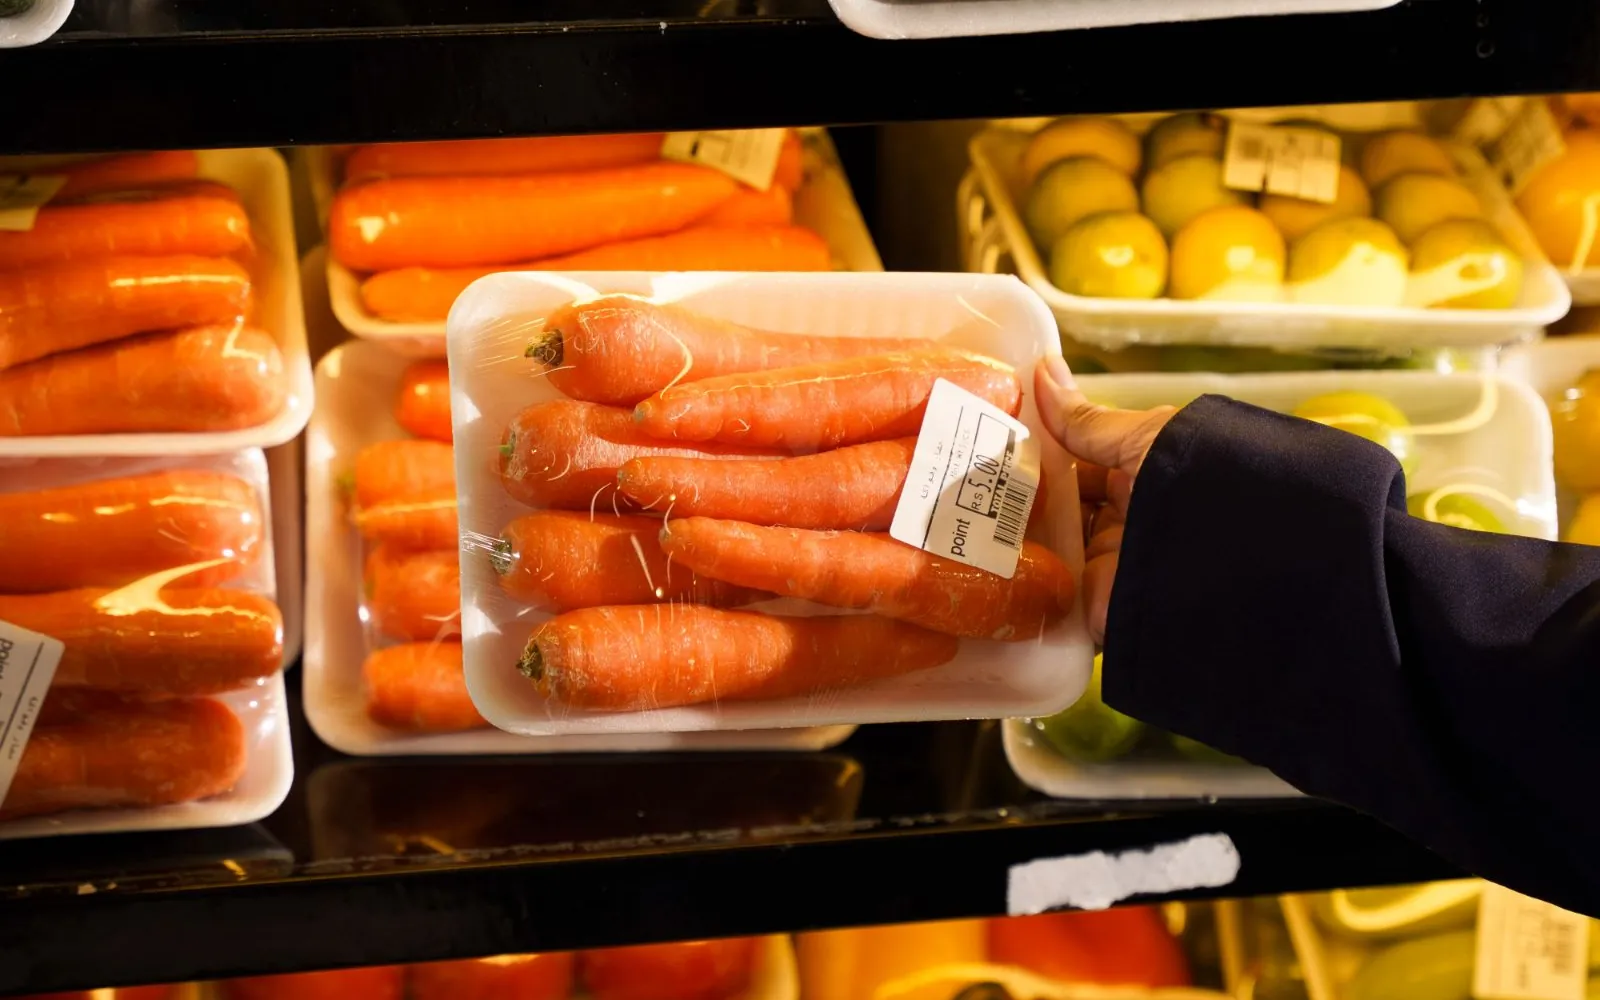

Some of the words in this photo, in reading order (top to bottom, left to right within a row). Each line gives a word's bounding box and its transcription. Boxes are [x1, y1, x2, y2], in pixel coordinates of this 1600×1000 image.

[968, 454, 1000, 493] 5.00
[971, 493, 984, 511] R.S
[991, 482, 1005, 513] TOTAL
[950, 518, 971, 558] point
